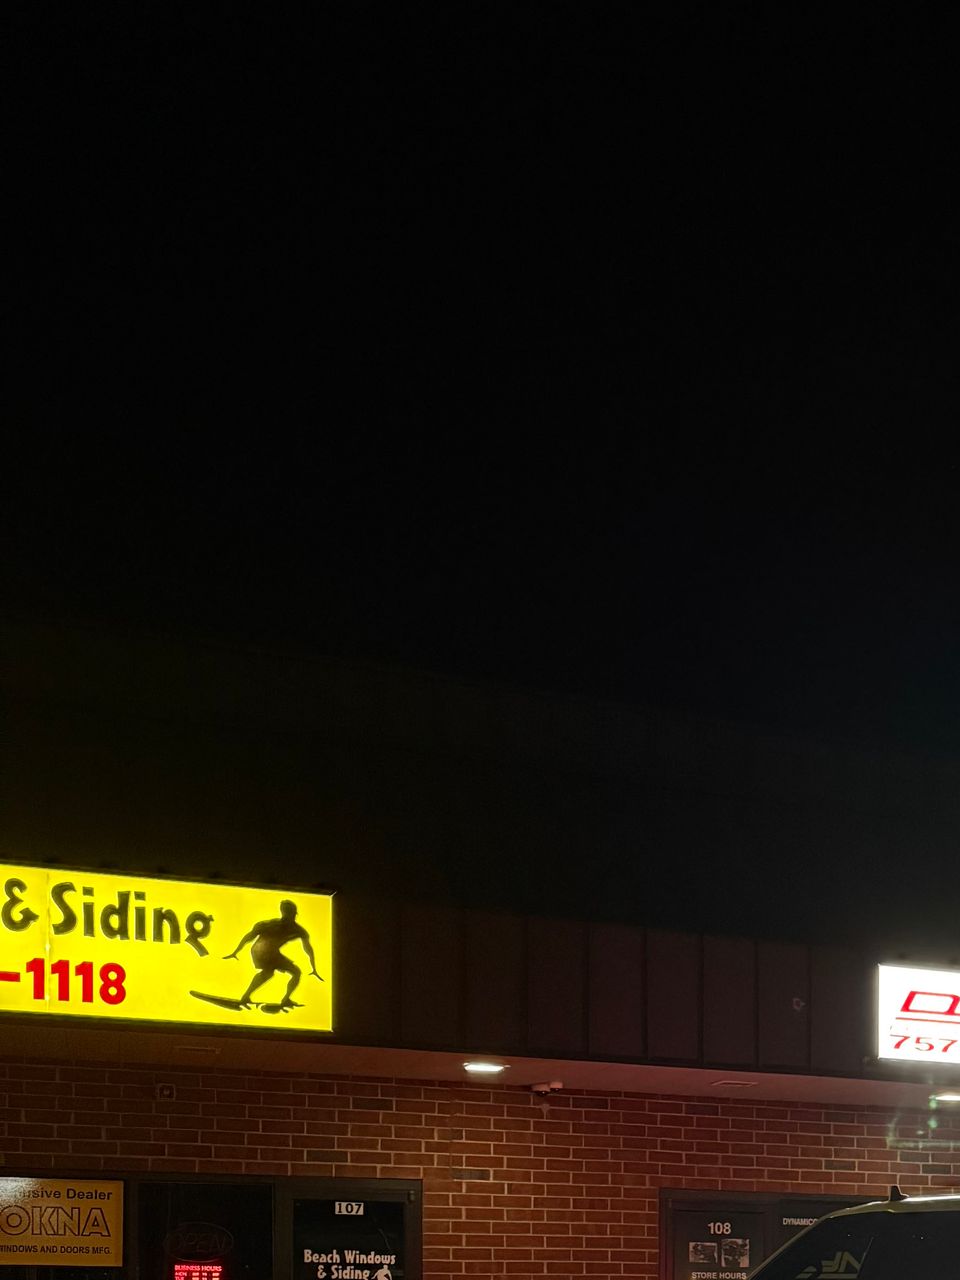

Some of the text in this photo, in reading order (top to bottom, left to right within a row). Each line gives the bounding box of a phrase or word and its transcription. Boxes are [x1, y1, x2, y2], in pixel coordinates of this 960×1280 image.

[1, 878, 214, 957] & Siding
[66, 1187, 113, 1200] Dealer
[337, 1203, 362, 1214] 107
[0, 1204, 111, 1238] OKNA
[707, 1221, 732, 1235] 108
[40, 1246, 58, 1254] AND
[60, 1246, 90, 1255] DOORS
[303, 1248, 397, 1265] Beach Windows
[317, 1264, 327, 1280] &
[691, 1271, 747, 1280] STORE HOURS
